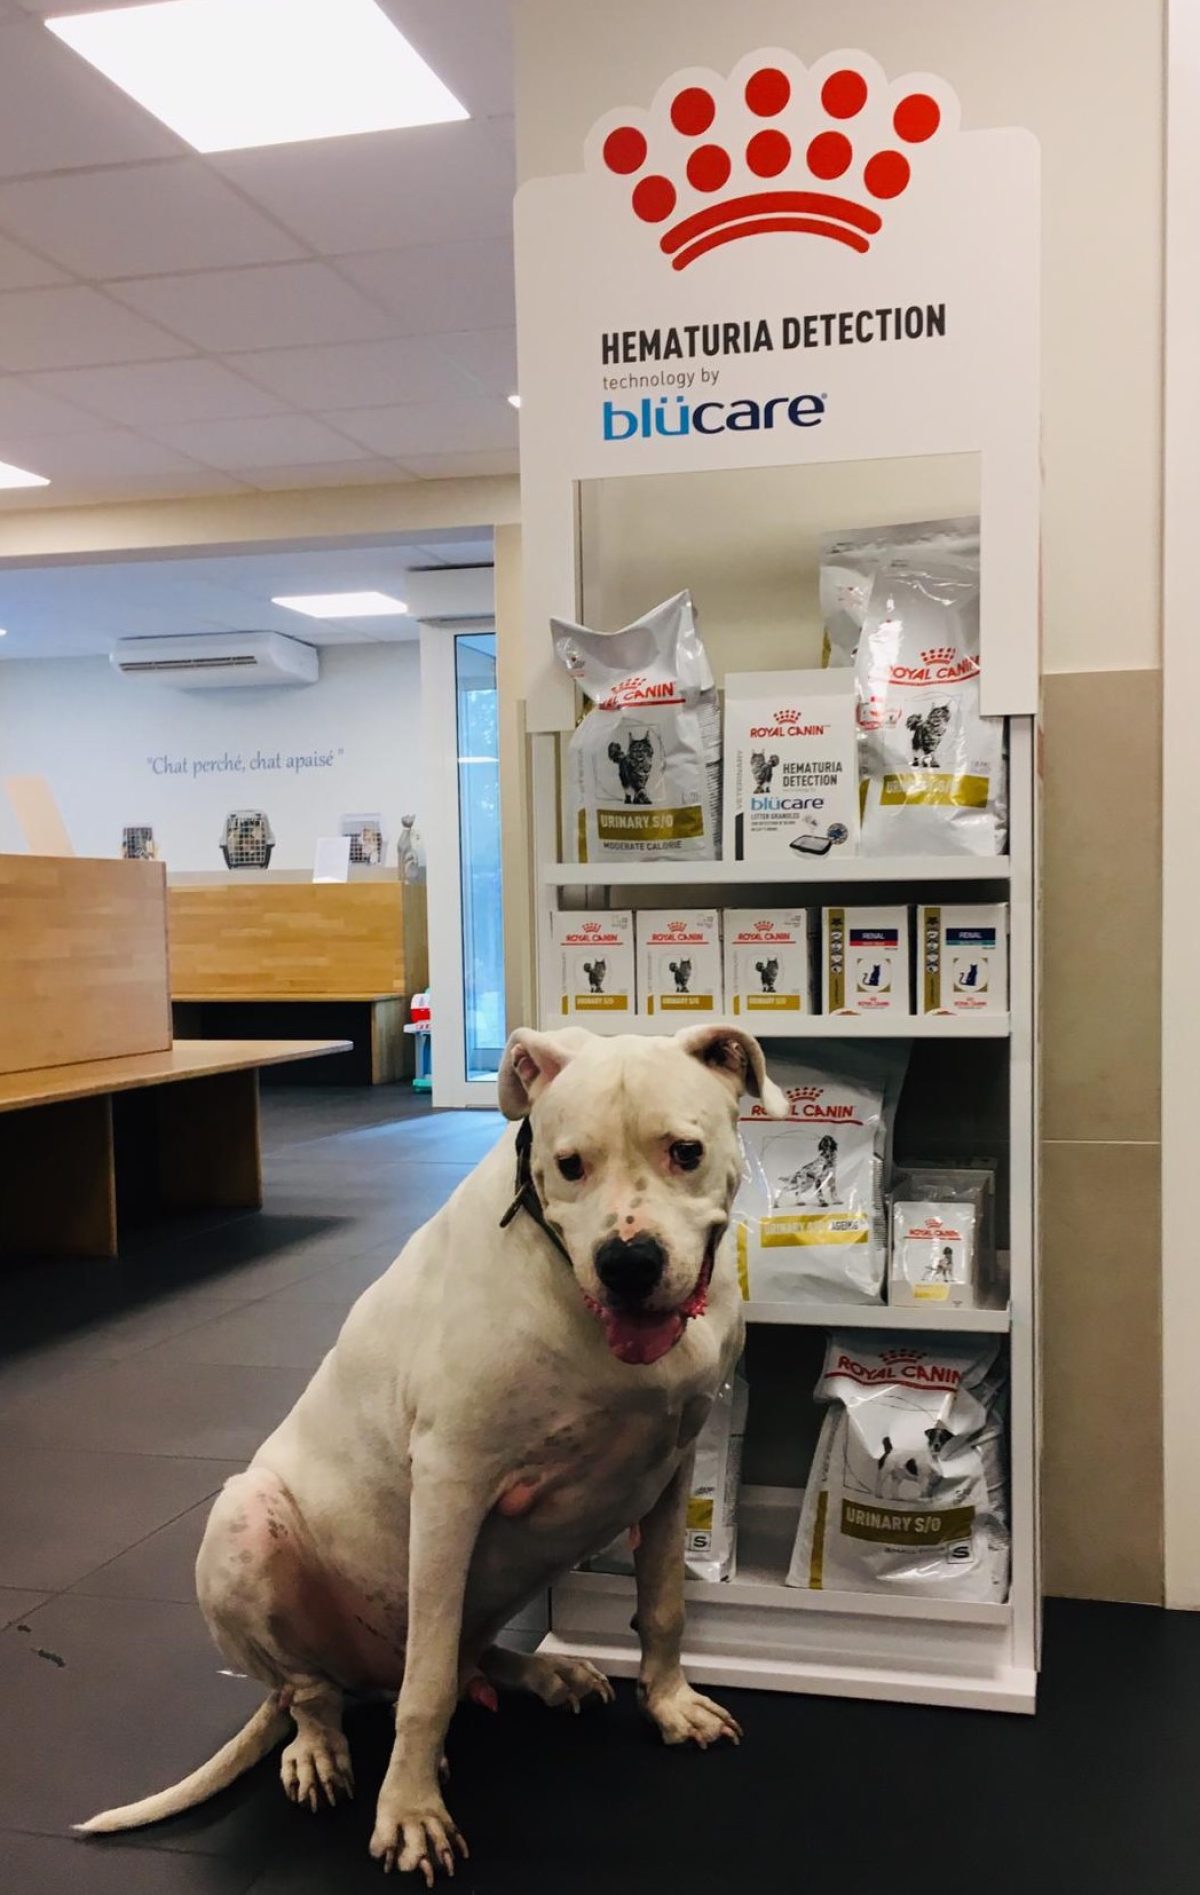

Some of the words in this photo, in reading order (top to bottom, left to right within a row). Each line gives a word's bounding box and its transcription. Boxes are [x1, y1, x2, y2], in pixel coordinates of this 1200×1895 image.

[602, 319, 773, 365] HEMATURIA
[782, 303, 946, 350] DETECTION
[602, 369, 695, 391] technology
[701, 368, 720, 386] by
[602, 394, 826, 441] blücare
[889, 665, 931, 680] OYAL
[750, 725, 785, 738] ROYAL
[787, 725, 824, 737] CANIN
[193, 752, 246, 779] perché,
[250, 751, 281, 771] chat
[782, 761, 843, 775] HEMATURIA
[782, 774, 837, 788] DETECTION
[751, 796, 824, 811] blücare
[600, 814, 649, 829] URINARY
[652, 814, 674, 829] S/O
[603, 841, 645, 851] MODERATE
[646, 840, 682, 851] CALORIE
[565, 934, 590, 942] ROYAL
[592, 934, 618, 942] CANIN
[652, 933, 676, 942] ROYAL
[677, 933, 703, 942] CANIN
[738, 932, 762, 941] ROYAL
[764, 932, 790, 941] CANIN
[861, 932, 885, 940] RENAL
[958, 931, 982, 939] RENAL
[803, 1104, 853, 1117] CANIN
[838, 1355, 896, 1380] ROYAL
[845, 1506, 912, 1532] URINARY
[914, 1515, 942, 1534] S/O
[693, 1535, 708, 1548] S
[952, 1546, 970, 1559] S
